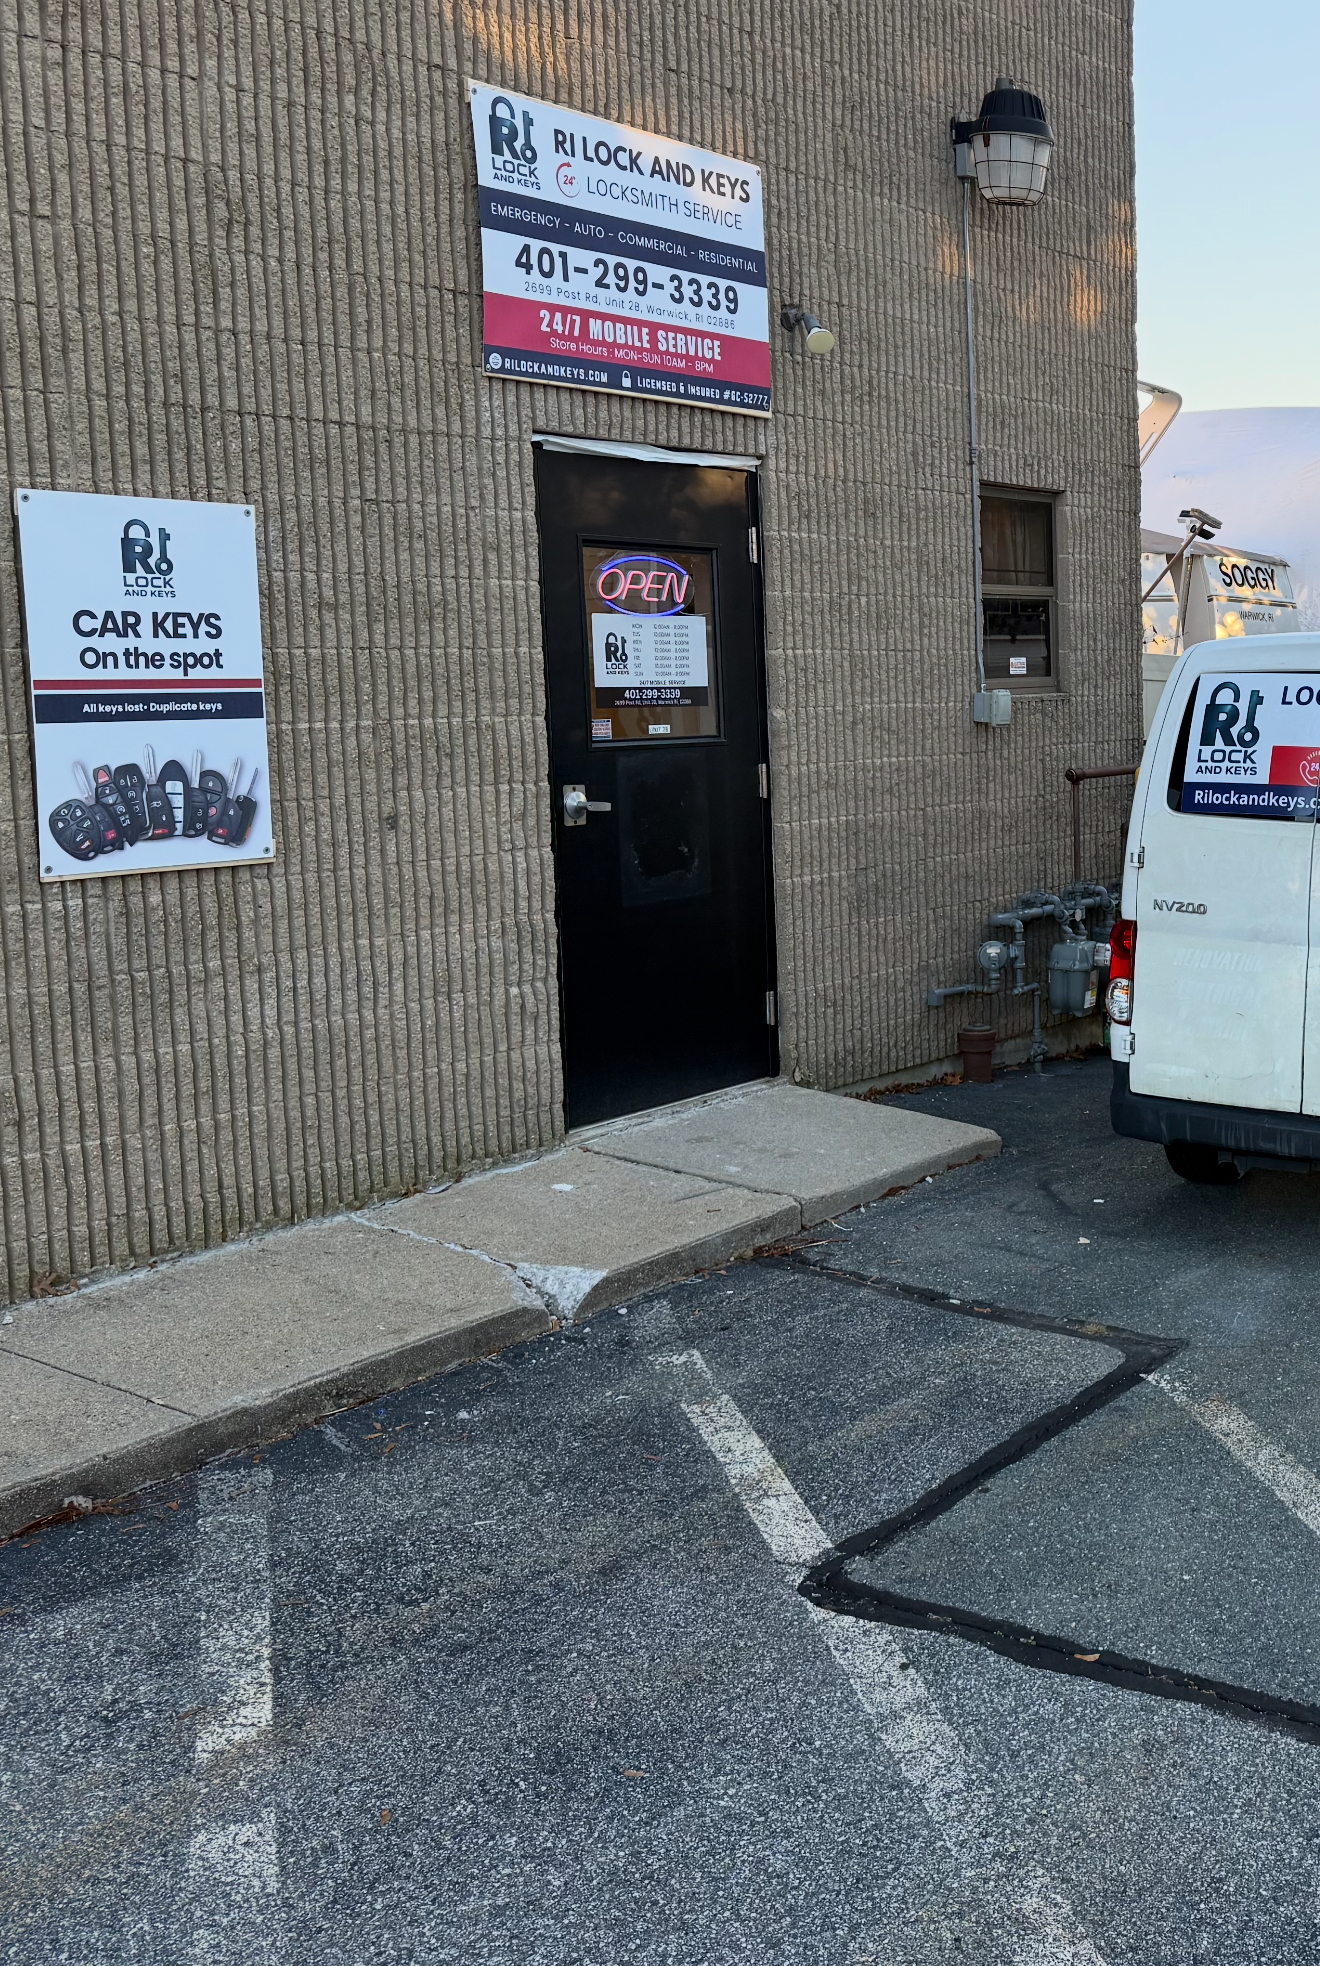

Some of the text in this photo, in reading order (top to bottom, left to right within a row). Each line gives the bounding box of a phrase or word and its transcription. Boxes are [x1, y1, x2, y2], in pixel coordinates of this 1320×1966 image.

[491, 157, 539, 180] LOCK
[553, 128, 751, 203] RI LOCK AND KEYS
[493, 172, 541, 191] AND KEYS
[587, 176, 743, 230] LOCKSMITH SERVICE
[490, 202, 560, 229] EMERGENCY
[574, 222, 605, 238] AUTO
[617, 231, 688, 257] COMMERCIAL
[698, 249, 758, 273] RESIDENTIAL
[514, 243, 739, 315] 401-299-3339
[524, 281, 736, 330] 2699 Post Rd, Unit 2B, Warwick, RI 02886
[539, 309, 721, 361] 24/7 MOBILE SERVICE
[550, 337, 577, 352] Store
[579, 341, 608, 357] Hours
[614, 347, 661, 365] MON-SUN
[662, 354, 686, 369] 10AM
[695, 360, 714, 374] 8PM
[504, 357, 608, 384] RILOCKANDKEYS.COM
[122, 575, 174, 589] LOCK
[597, 568, 689, 604] OPEN
[1218, 562, 1276, 591] SOGGY
[124, 589, 176, 598] AND KEYS
[72, 609, 223, 639] CAR KEYS
[1239, 610, 1268, 622] WARWICK,
[79, 646, 223, 677] On the spot
[605, 662, 629, 670] LOCK
[624, 688, 681, 700] 401-299-3339
[82, 703, 97, 713] All
[98, 703, 123, 715] keys
[150, 701, 197, 714] Duplicate
[199, 701, 223, 713] keys
[1197, 748, 1257, 764] LOCK
[1195, 765, 1257, 776] AND KEYS
[1153, 898, 1207, 915] NV200
